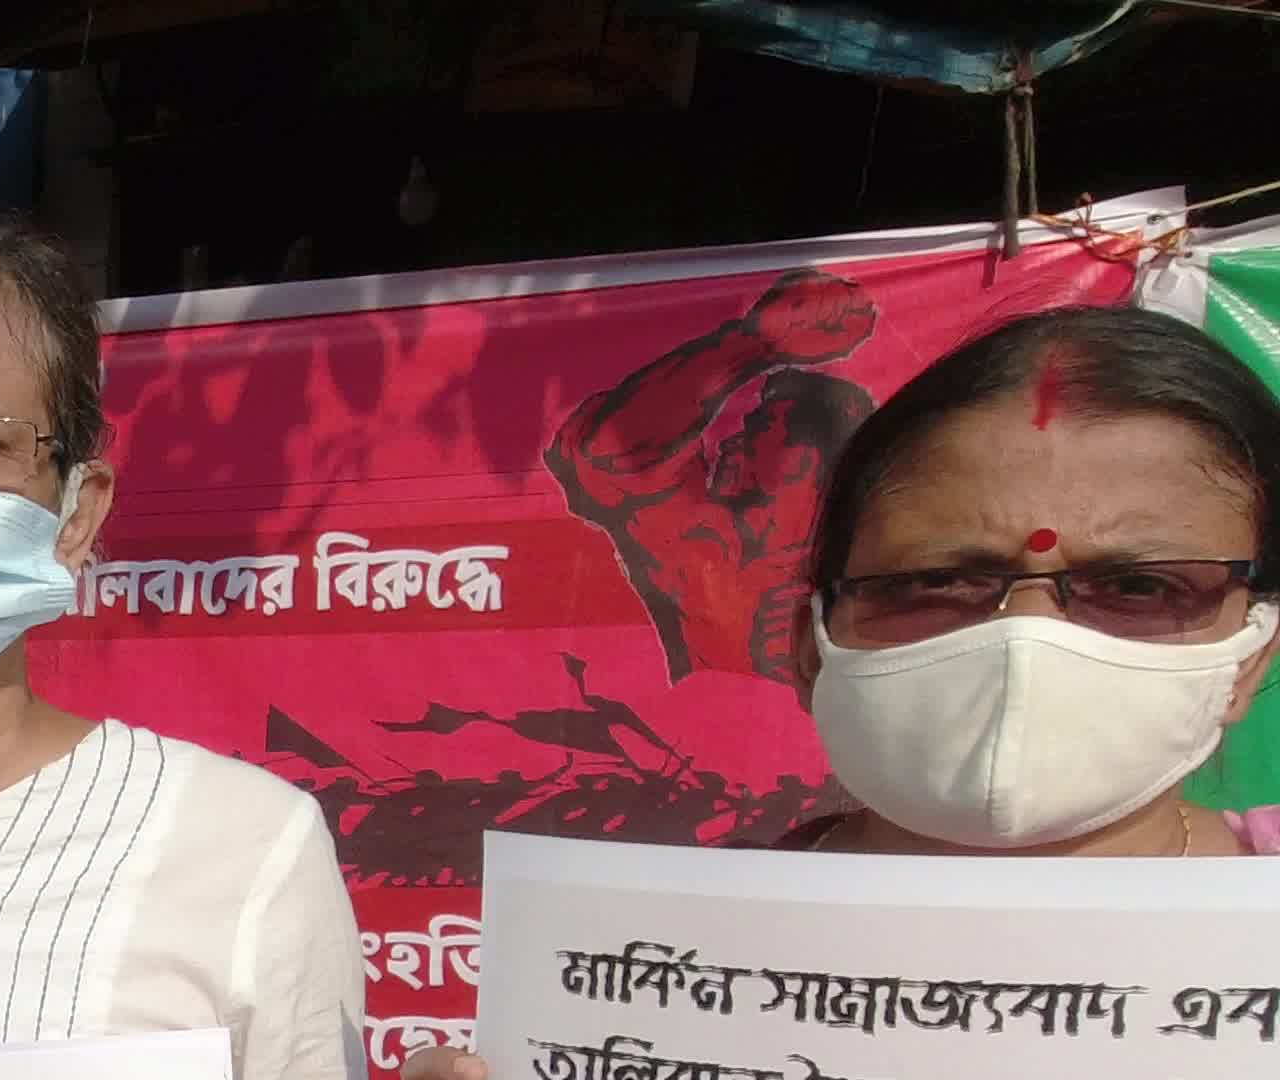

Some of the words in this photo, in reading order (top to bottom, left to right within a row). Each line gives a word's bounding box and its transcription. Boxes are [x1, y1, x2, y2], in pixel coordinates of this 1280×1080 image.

[312, 531, 509, 613] বিরুদ্ধে
[554, 940, 753, 1015] মার্কিন
[760, 969, 1150, 1037] সাম্রাজ্যবাদ
[1156, 986, 1280, 1042] এব
